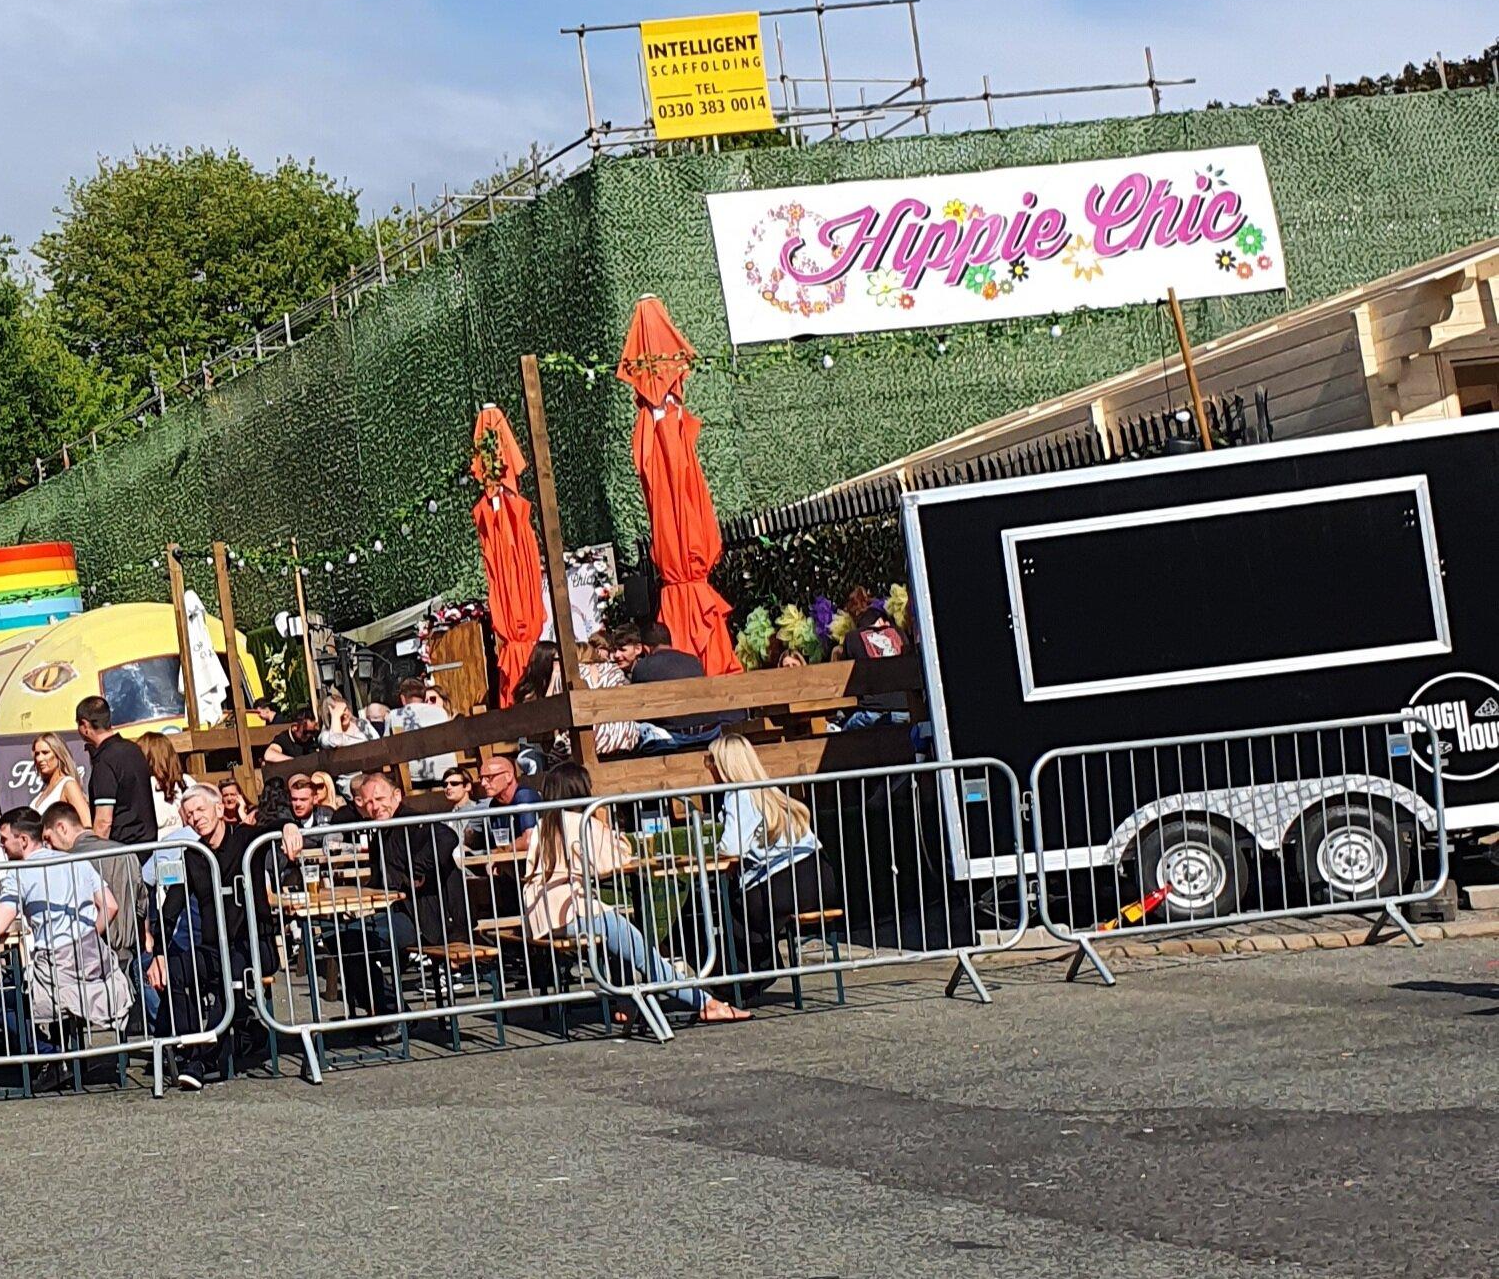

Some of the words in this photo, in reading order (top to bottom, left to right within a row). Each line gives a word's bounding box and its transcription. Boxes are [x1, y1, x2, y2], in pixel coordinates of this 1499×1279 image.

[647, 34, 758, 60] INTELLIGENT
[651, 56, 761, 77] SCAFFOLDING
[695, 83, 724, 96] TEL.
[658, 102, 694, 119] 0330
[699, 99, 726, 115] 383
[731, 95, 766, 112] 0014
[780, 191, 1071, 290] Hippie
[1084, 172, 1248, 258] Chic
[1401, 700, 1468, 735] DOUGH
[1456, 715, 1499, 752] HOU
